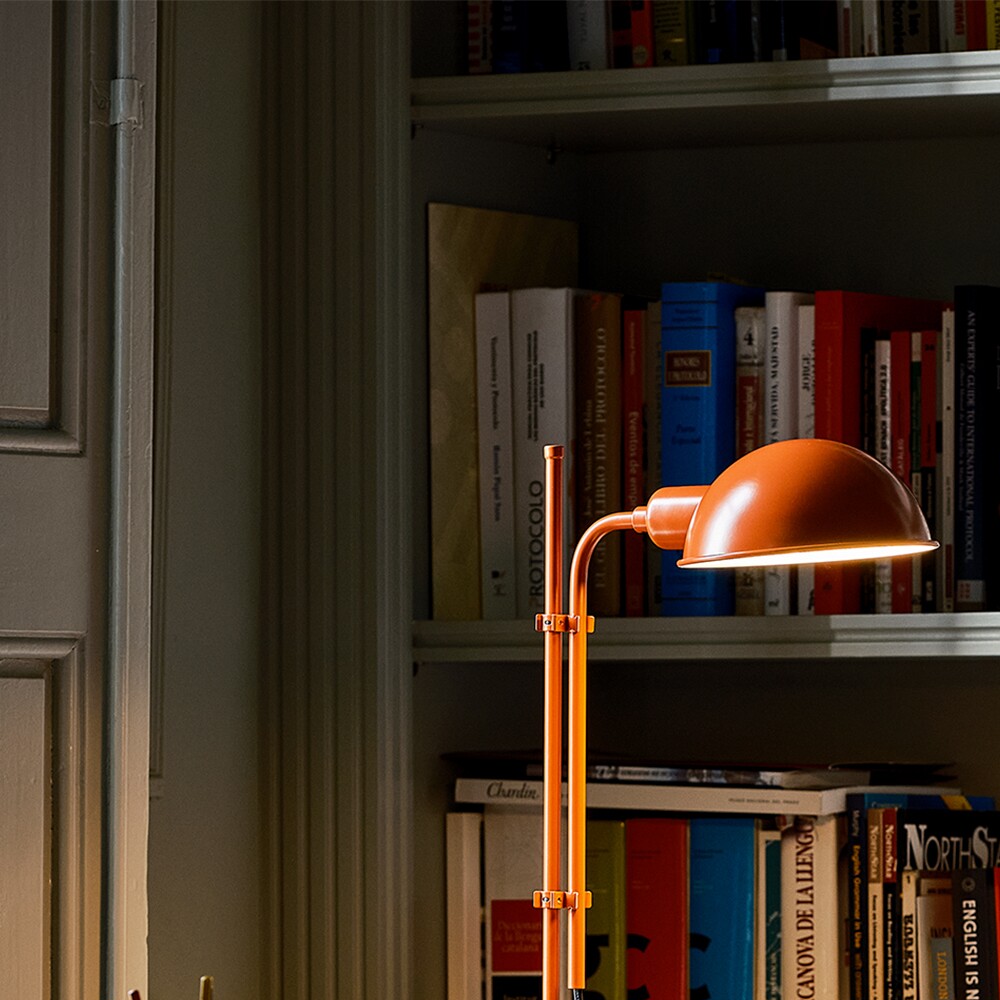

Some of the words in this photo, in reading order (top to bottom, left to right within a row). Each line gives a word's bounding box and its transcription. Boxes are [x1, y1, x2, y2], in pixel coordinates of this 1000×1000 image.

[487, 781, 539, 801] Chardin
[795, 824, 814, 883] LLENGU
[851, 845, 861, 876] English
[795, 885, 814, 905] LA
[853, 877, 862, 919] Grammar
[796, 908, 814, 931] DE
[854, 921, 862, 931] in
[962, 899, 979, 967] ENGLISH
[854, 932, 862, 949] Use
[903, 914, 914, 990] LLENGUA
[936, 952, 949, 1000] LONDON
[965, 971, 979, 985] IS
